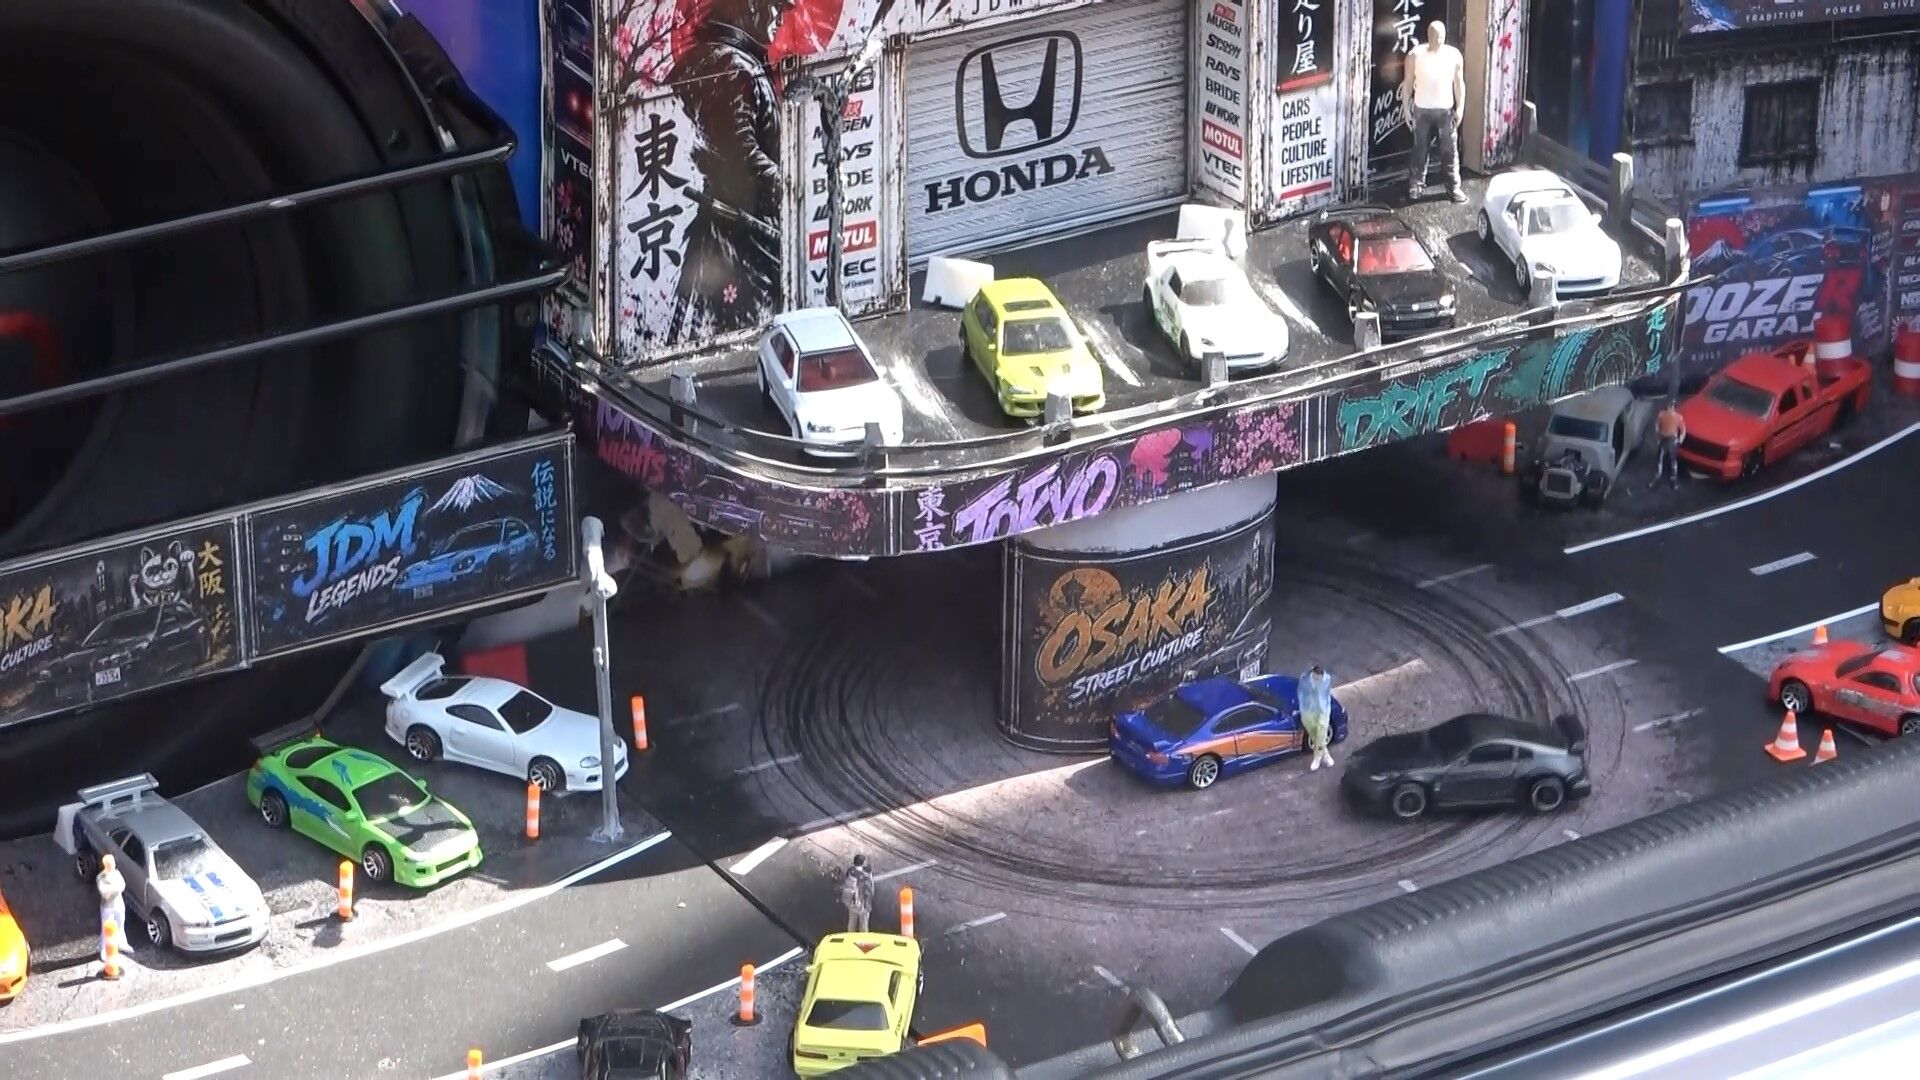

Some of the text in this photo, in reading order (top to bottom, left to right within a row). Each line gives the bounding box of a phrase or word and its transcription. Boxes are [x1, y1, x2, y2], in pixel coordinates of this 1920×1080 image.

[1206, 12, 1242, 37] MUGEN
[1746, 11, 1804, 23] TRADITION
[1825, 4, 1861, 15] POWER
[1206, 56, 1241, 81] RAYS
[1206, 76, 1241, 106] BRIDE
[1373, 90, 1393, 115] NO
[1216, 106, 1240, 127] WORK
[1282, 97, 1310, 120] CARS
[813, 114, 873, 140] MGEN
[1204, 124, 1241, 155] MOTUL
[1282, 116, 1322, 143] PEOPLE
[812, 140, 874, 169] RYS
[1202, 148, 1242, 180] VTEC
[1281, 138, 1328, 165] CULTURE
[812, 168, 874, 195] BDE
[925, 146, 1115, 214] HONDA
[1281, 158, 1333, 187] LIFESTYLE
[625, 113, 690, 281] 東京
[813, 226, 874, 256] MTUL
[810, 257, 876, 283] VEC
[1338, 349, 1513, 452] DRIFT
[953, 455, 1119, 543] TOKYO
[913, 486, 950, 551] 東京
[292, 487, 424, 597] JDM
[197, 541, 226, 599] 大阪
[304, 556, 401, 623] LEGENDS
[1036, 562, 1216, 684] OSAKA
[0, 633, 54, 671] CULTURE
[1068, 657, 1140, 700] STREET
[1139, 626, 1205, 672] CULTURE
